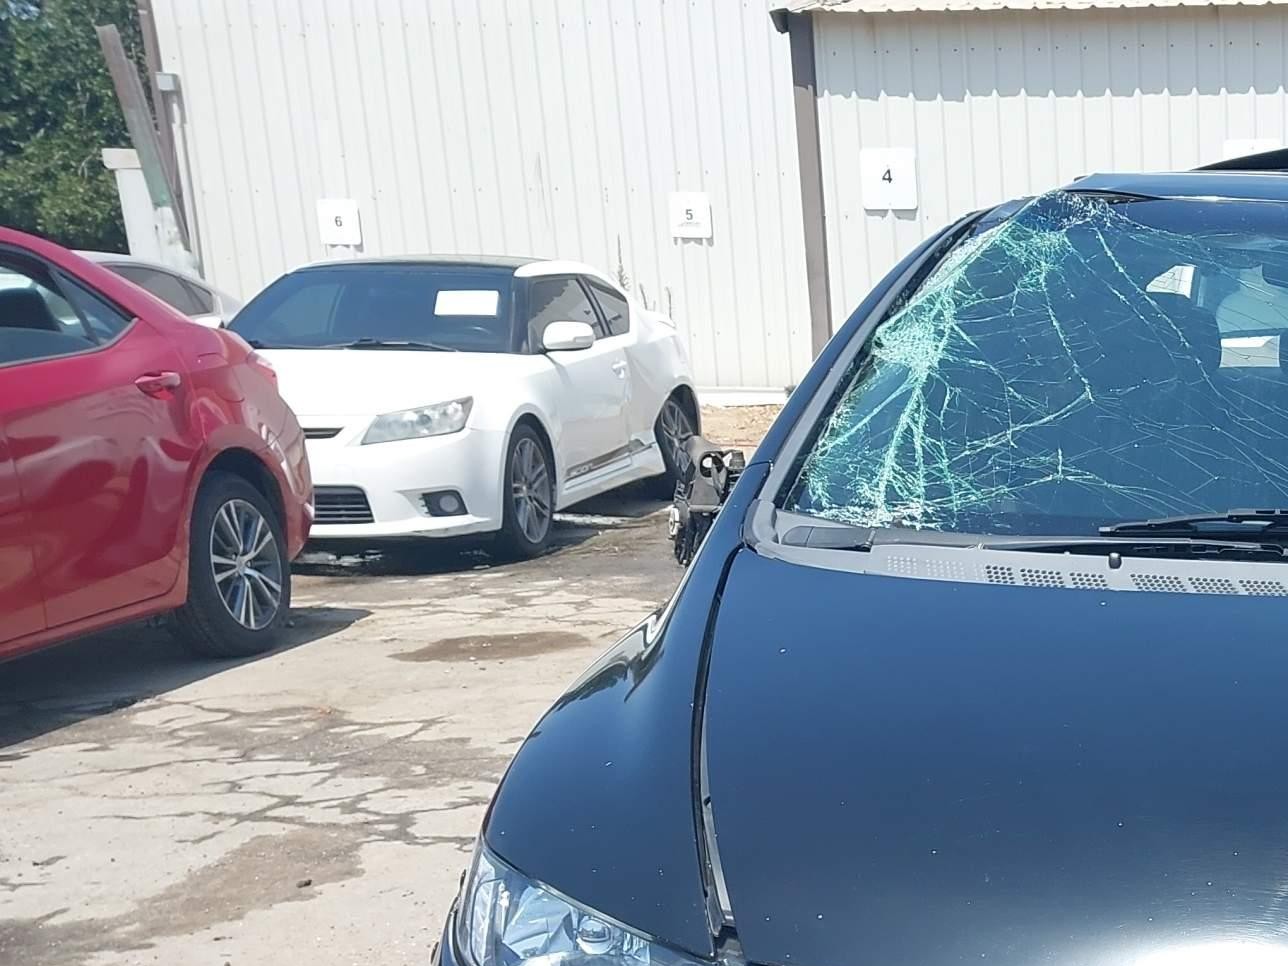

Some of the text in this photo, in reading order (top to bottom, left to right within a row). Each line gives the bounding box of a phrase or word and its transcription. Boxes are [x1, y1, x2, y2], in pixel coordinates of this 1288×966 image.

[882, 168, 893, 184] 4
[685, 208, 694, 221] 5
[334, 215, 343, 228] 6
